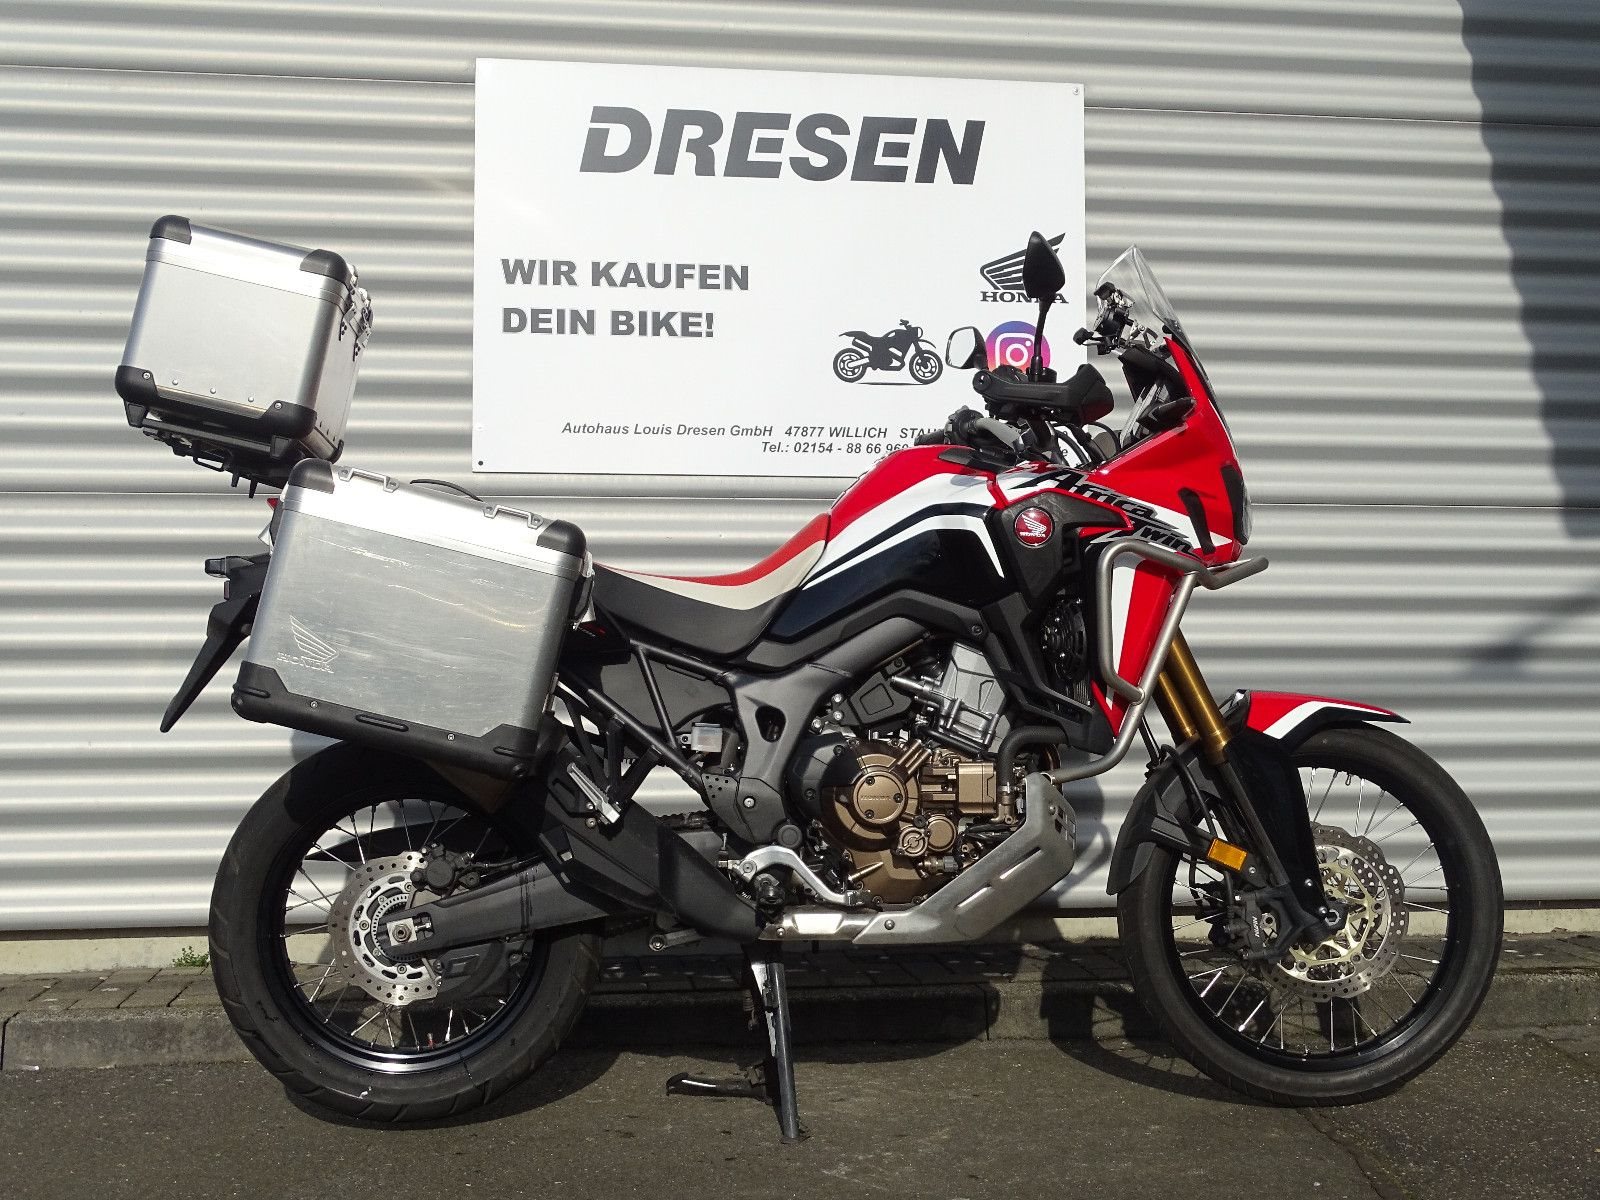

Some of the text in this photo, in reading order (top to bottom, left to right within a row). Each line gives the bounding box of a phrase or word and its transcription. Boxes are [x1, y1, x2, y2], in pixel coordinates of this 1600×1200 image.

[580, 105, 986, 185] DRESEN
[501, 258, 750, 291] WIR KAUFEN
[980, 290, 1069, 304] HONA
[502, 307, 715, 338] DEIN BIKE!
[561, 422, 630, 435] Autohaus
[633, 423, 673, 435] Louis
[676, 424, 726, 436] Dresen
[730, 424, 774, 437] GmbH
[784, 425, 825, 438] 47877
[829, 426, 888, 438] WILLICH
[761, 441, 790, 453] Tel.:
[793, 442, 834, 453] 02154
[846, 442, 862, 454] 88
[865, 442, 882, 454] 66
